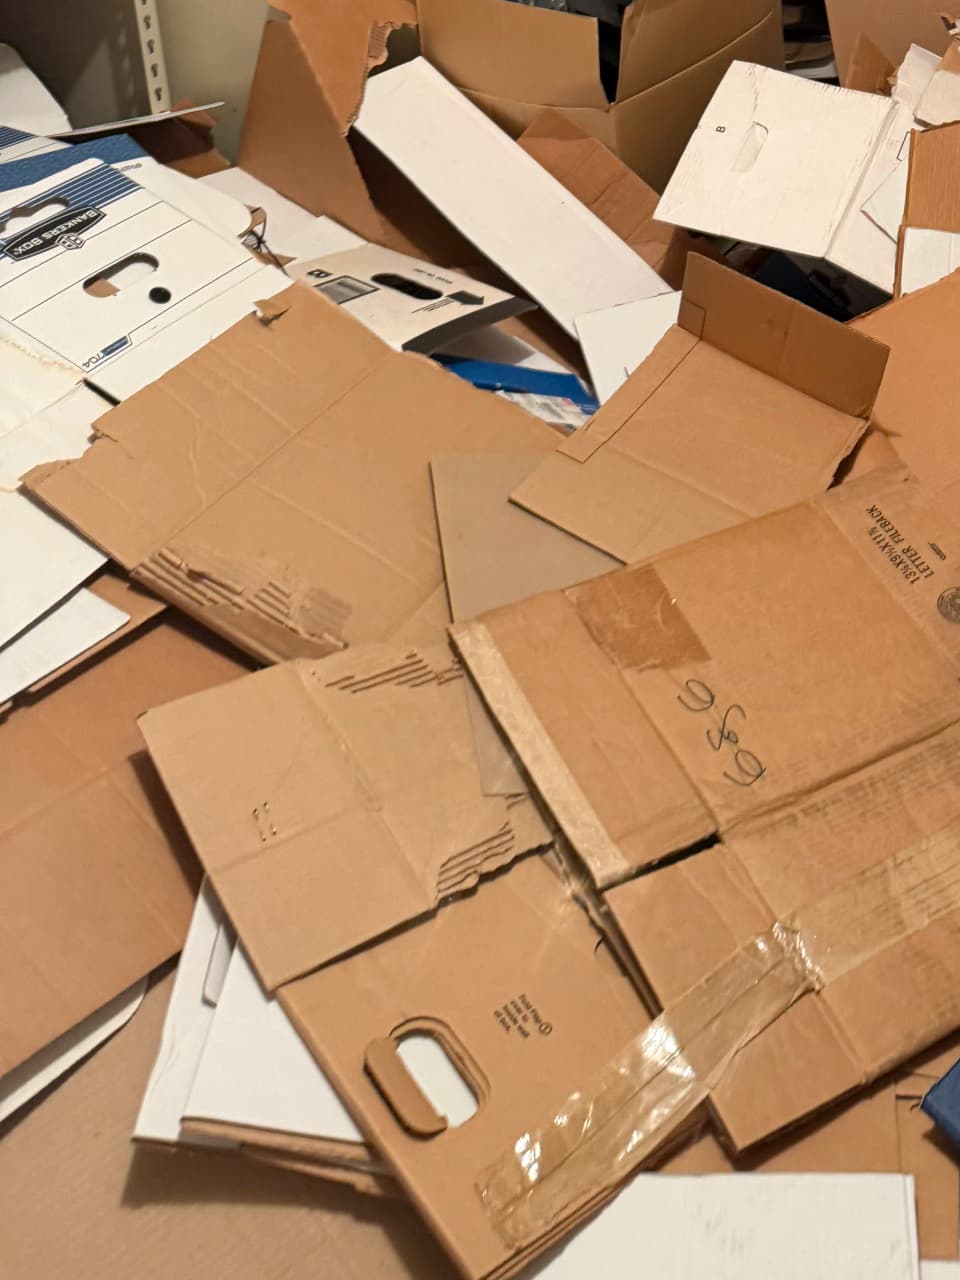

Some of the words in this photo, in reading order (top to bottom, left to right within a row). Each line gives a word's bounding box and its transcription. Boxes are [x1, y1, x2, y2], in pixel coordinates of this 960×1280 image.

[45, 210, 98, 240] BANKERS
[14, 238, 43, 255] BOX
[866, 504, 905, 545] FILEBACK
[902, 545, 935, 579] LETTER
